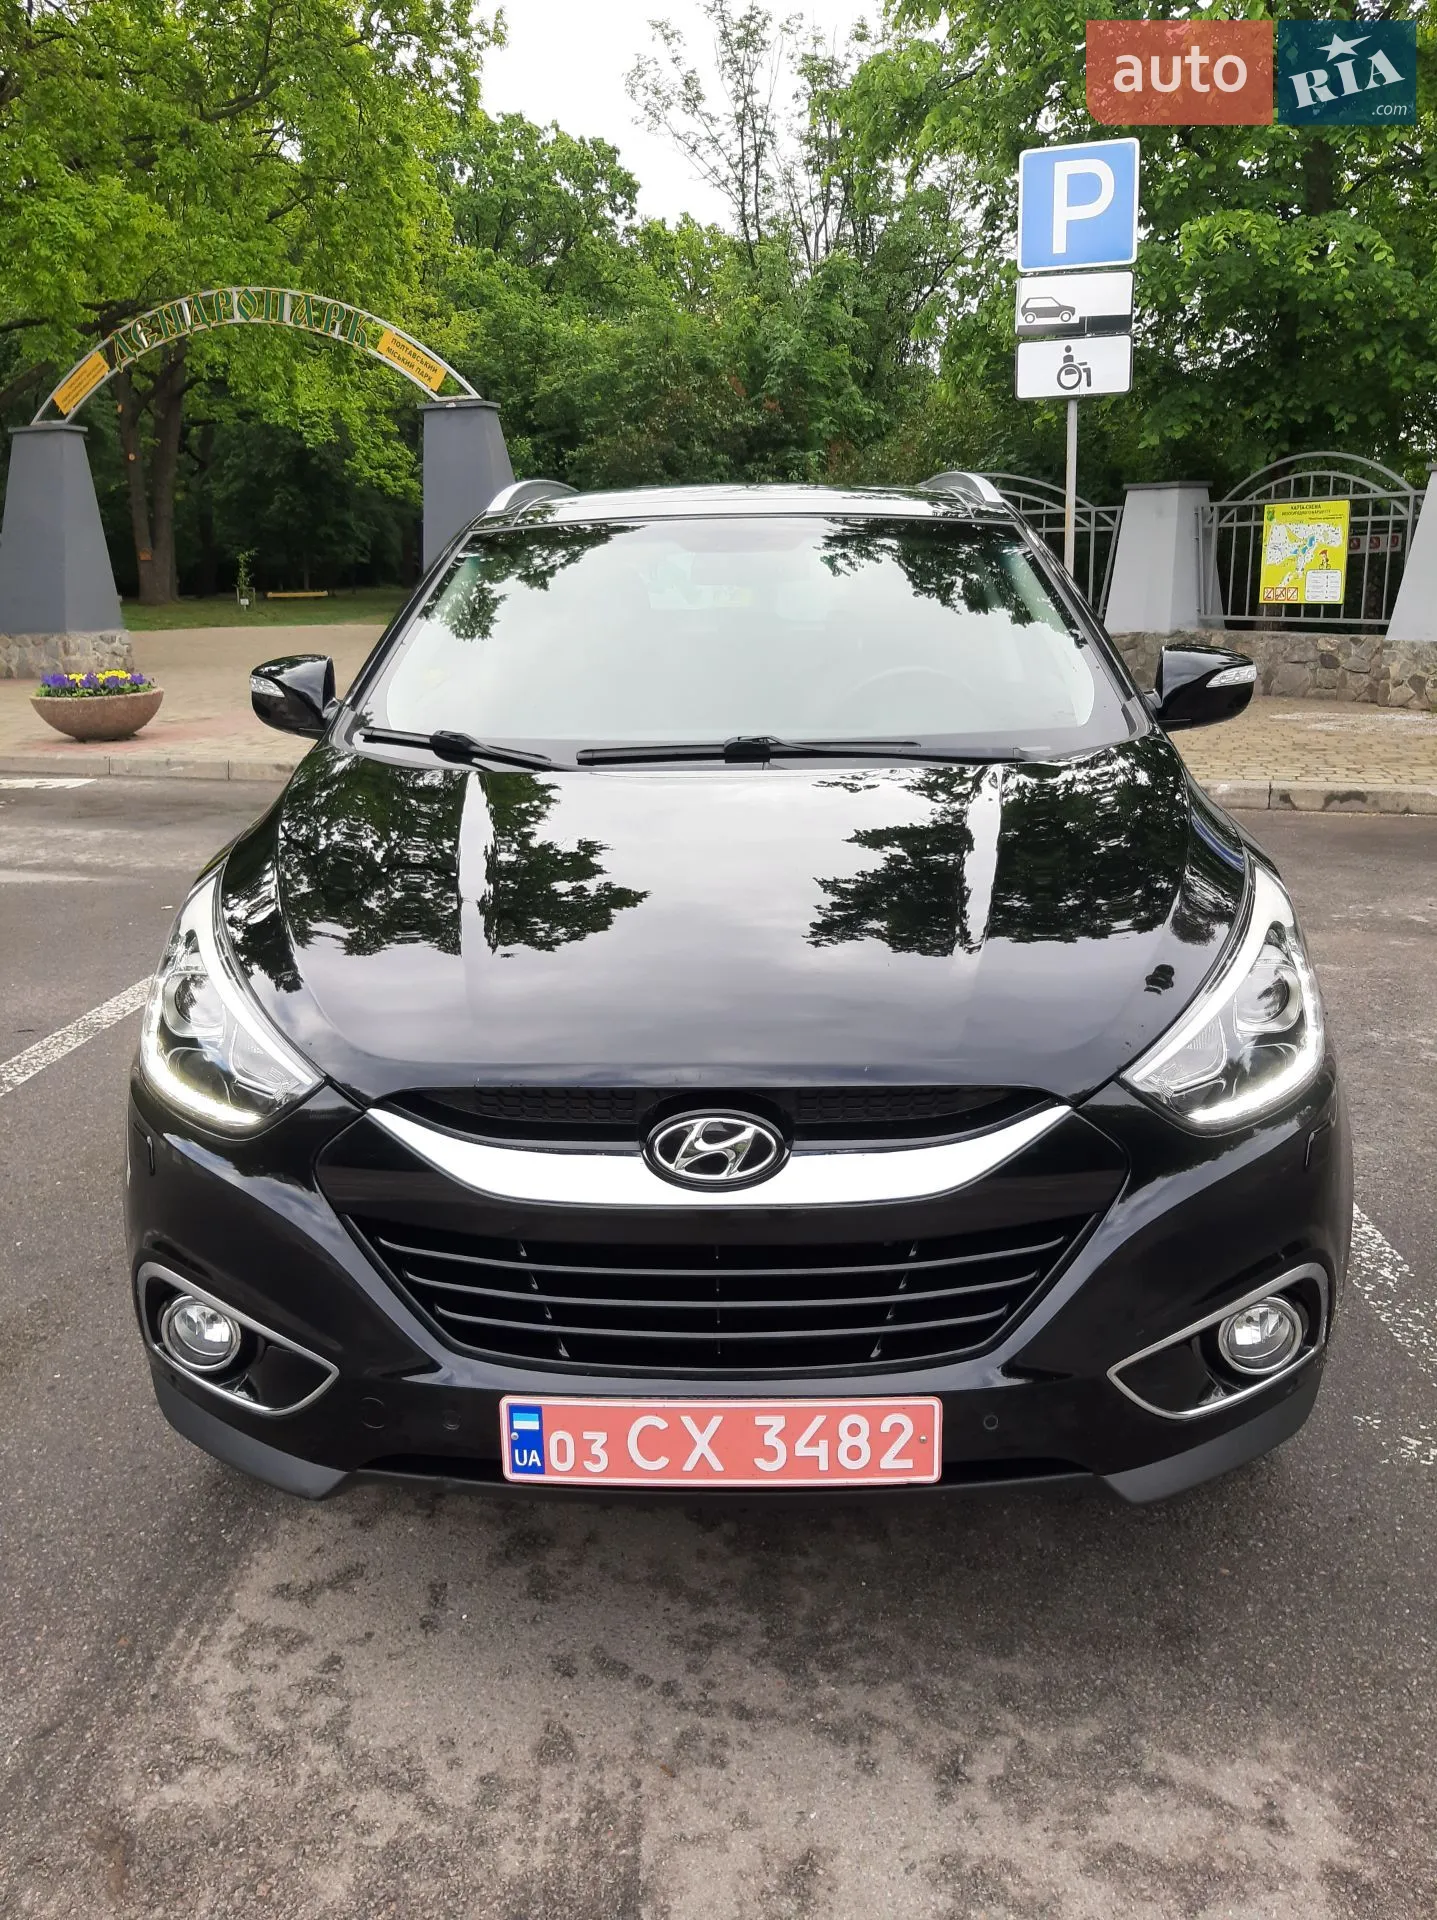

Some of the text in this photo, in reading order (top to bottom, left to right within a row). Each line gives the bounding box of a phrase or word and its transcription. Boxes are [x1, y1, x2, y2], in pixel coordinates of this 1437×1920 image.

[1052, 159, 1115, 254] P
[415, 367, 433, 383] ПАРК
[514, 1448, 542, 1467] UA
[549, 1413, 914, 1473] 03 CX 3482
